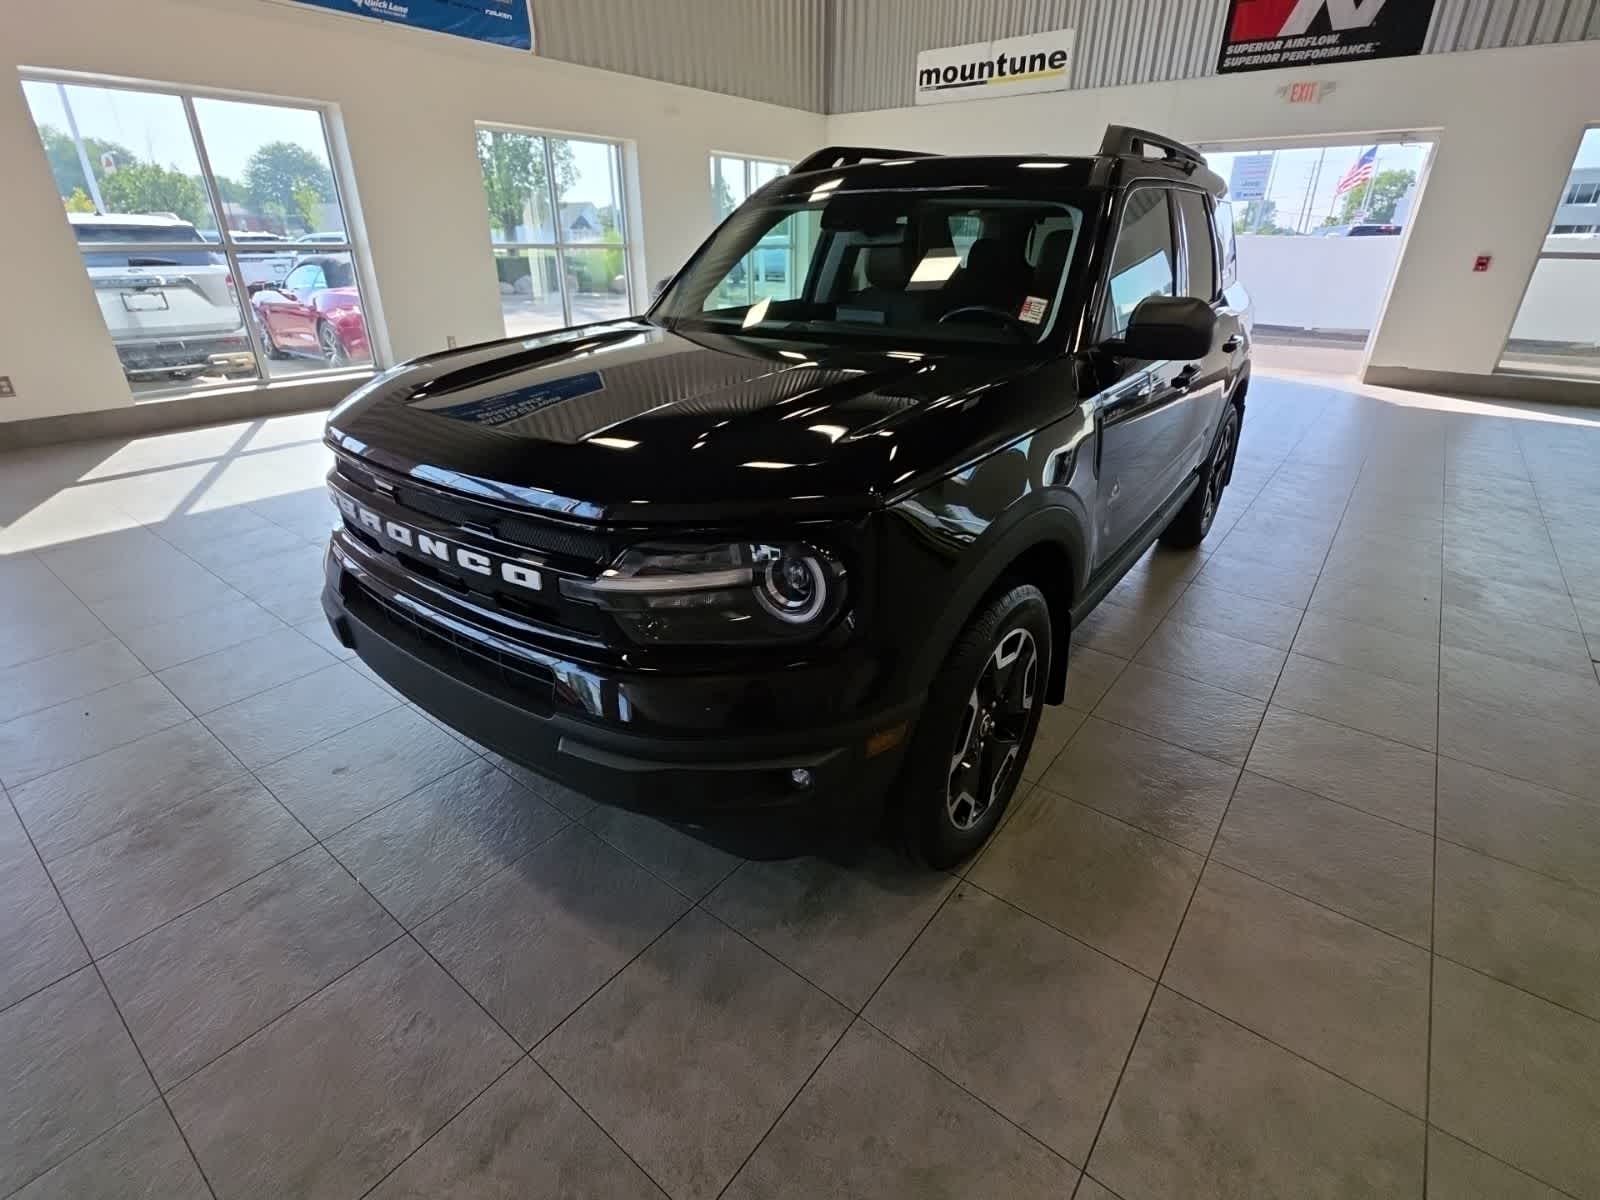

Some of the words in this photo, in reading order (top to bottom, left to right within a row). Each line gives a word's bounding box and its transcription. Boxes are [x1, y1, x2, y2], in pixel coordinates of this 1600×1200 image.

[1226, 40, 1283, 55] SUPERIOR
[918, 49, 1068, 87] mountune
[1223, 53, 1281, 68] SUPERIOR
[1291, 82, 1318, 103] EXIT
[340, 496, 543, 591] BRONCO
